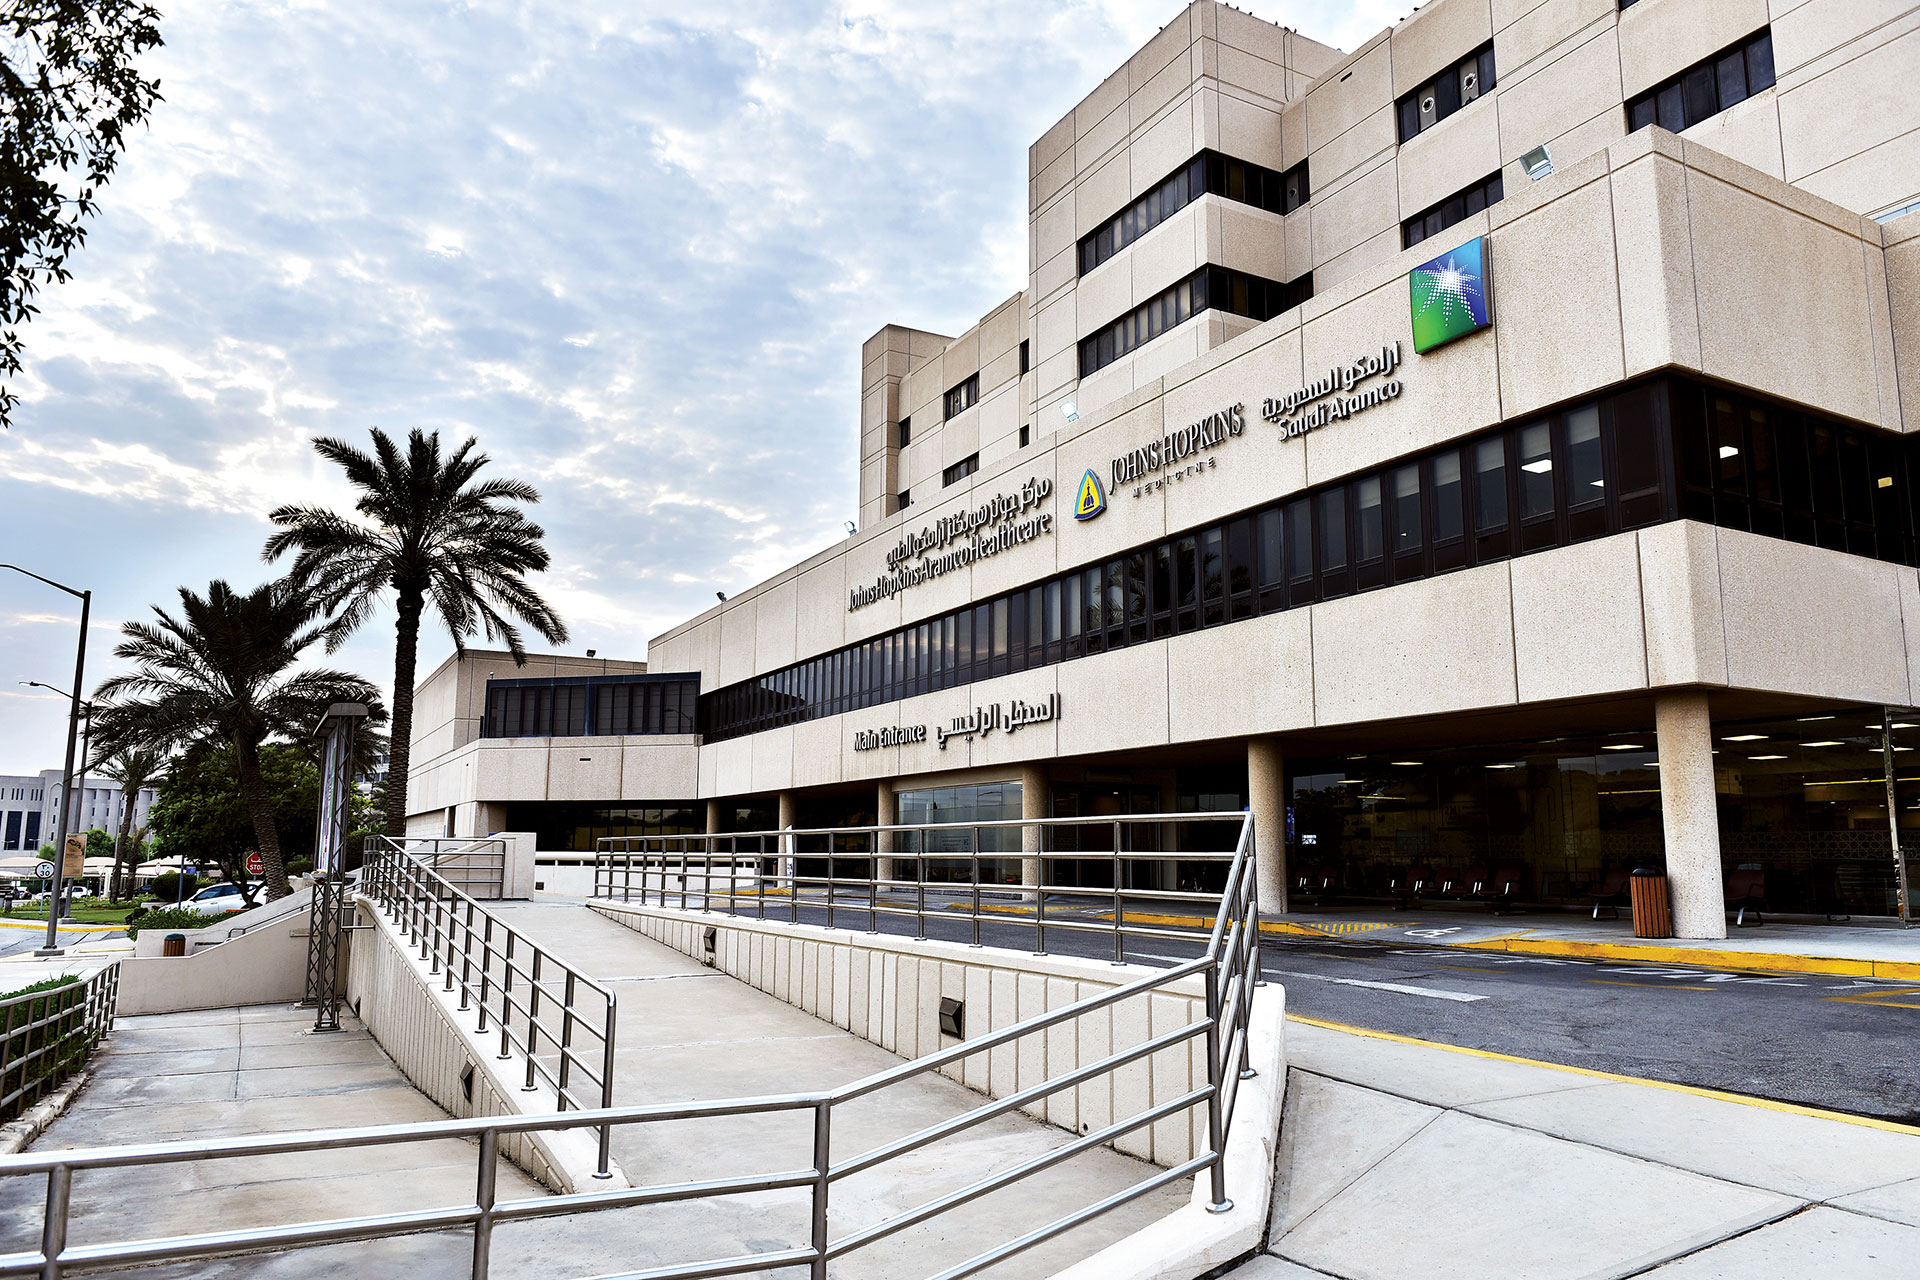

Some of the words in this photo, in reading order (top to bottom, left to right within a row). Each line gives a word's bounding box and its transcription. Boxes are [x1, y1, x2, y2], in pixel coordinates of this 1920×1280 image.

[1260, 366, 1342, 423] السعودية
[1278, 403, 1328, 441] Saudi
[1327, 380, 1402, 423] Aramco
[1108, 439, 1162, 496] JOHNS
[1161, 402, 1246, 467] HOPKINS
[1019, 476, 1052, 514] مركز
[1133, 456, 1217, 499] MEDICINE
[946, 503, 989, 546] هوبكنز
[988, 493, 1018, 527] جونز
[887, 532, 914, 572] الطبي
[848, 582, 877, 612] Johns
[875, 564, 921, 600] Hopkins
[935, 702, 1001, 750] الرئيسي
[1002, 692, 1062, 734] المدخل
[854, 728, 879, 752] Main
[879, 723, 927, 747] Entrance
